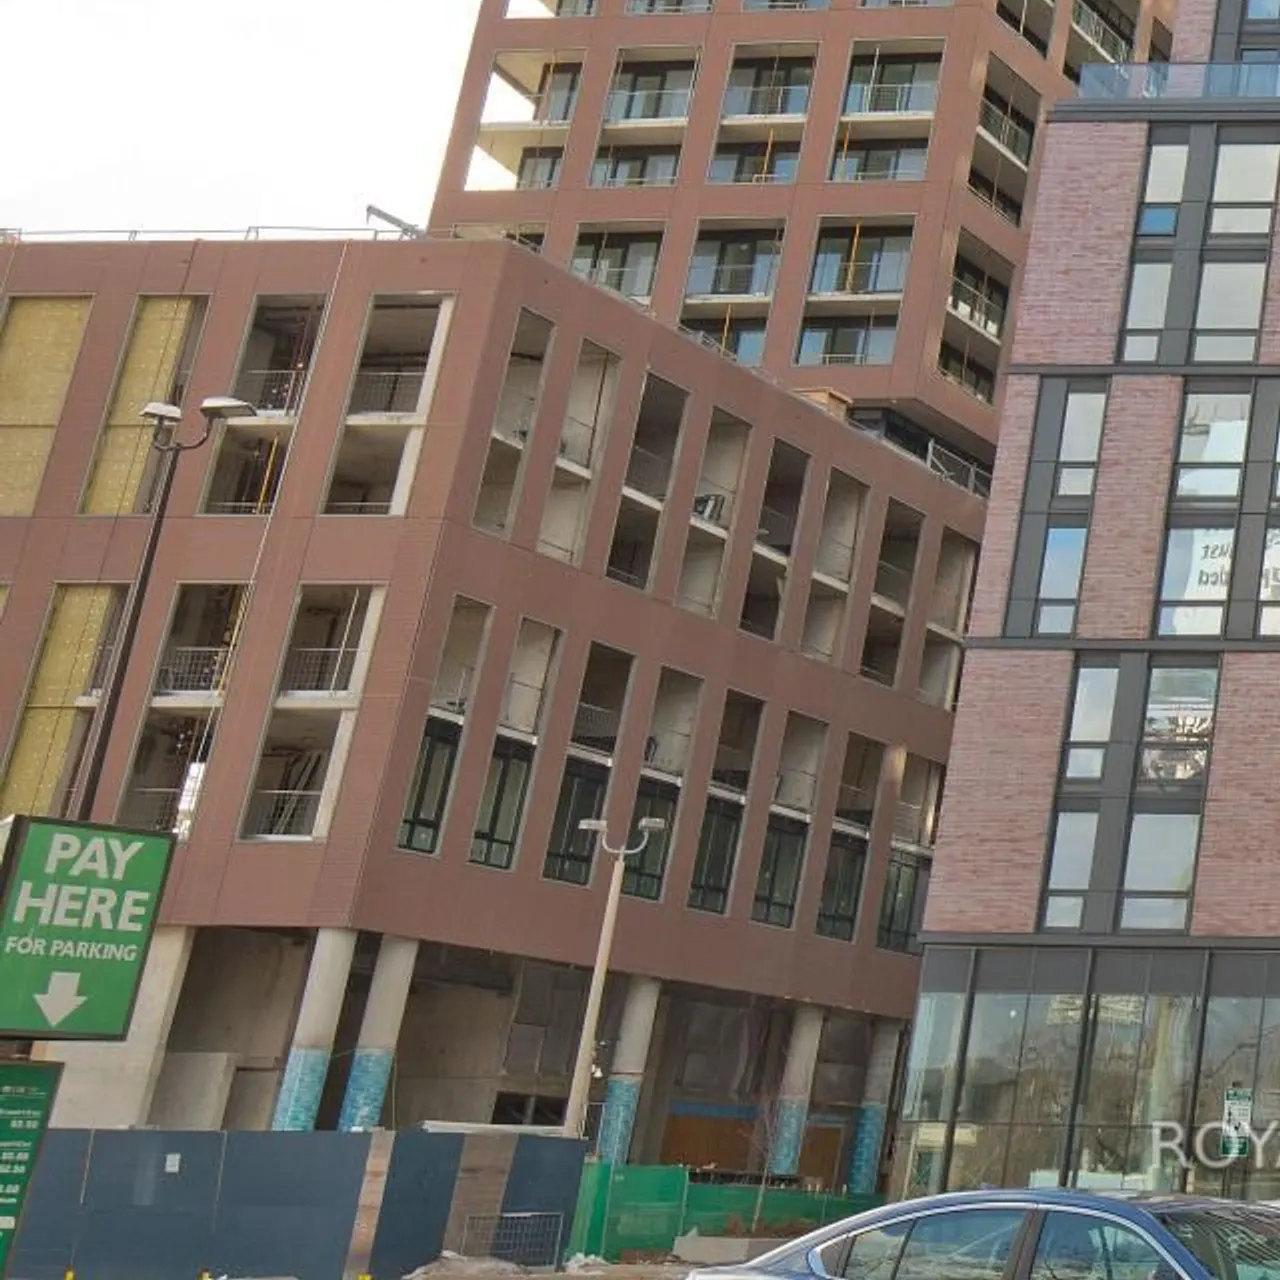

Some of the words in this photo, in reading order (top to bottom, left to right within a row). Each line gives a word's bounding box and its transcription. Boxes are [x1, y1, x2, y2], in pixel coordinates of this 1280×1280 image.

[44, 833, 145, 880] PAY
[13, 880, 150, 933] HERE
[4, 935, 46, 956] FOR
[50, 939, 139, 962] PARKING
